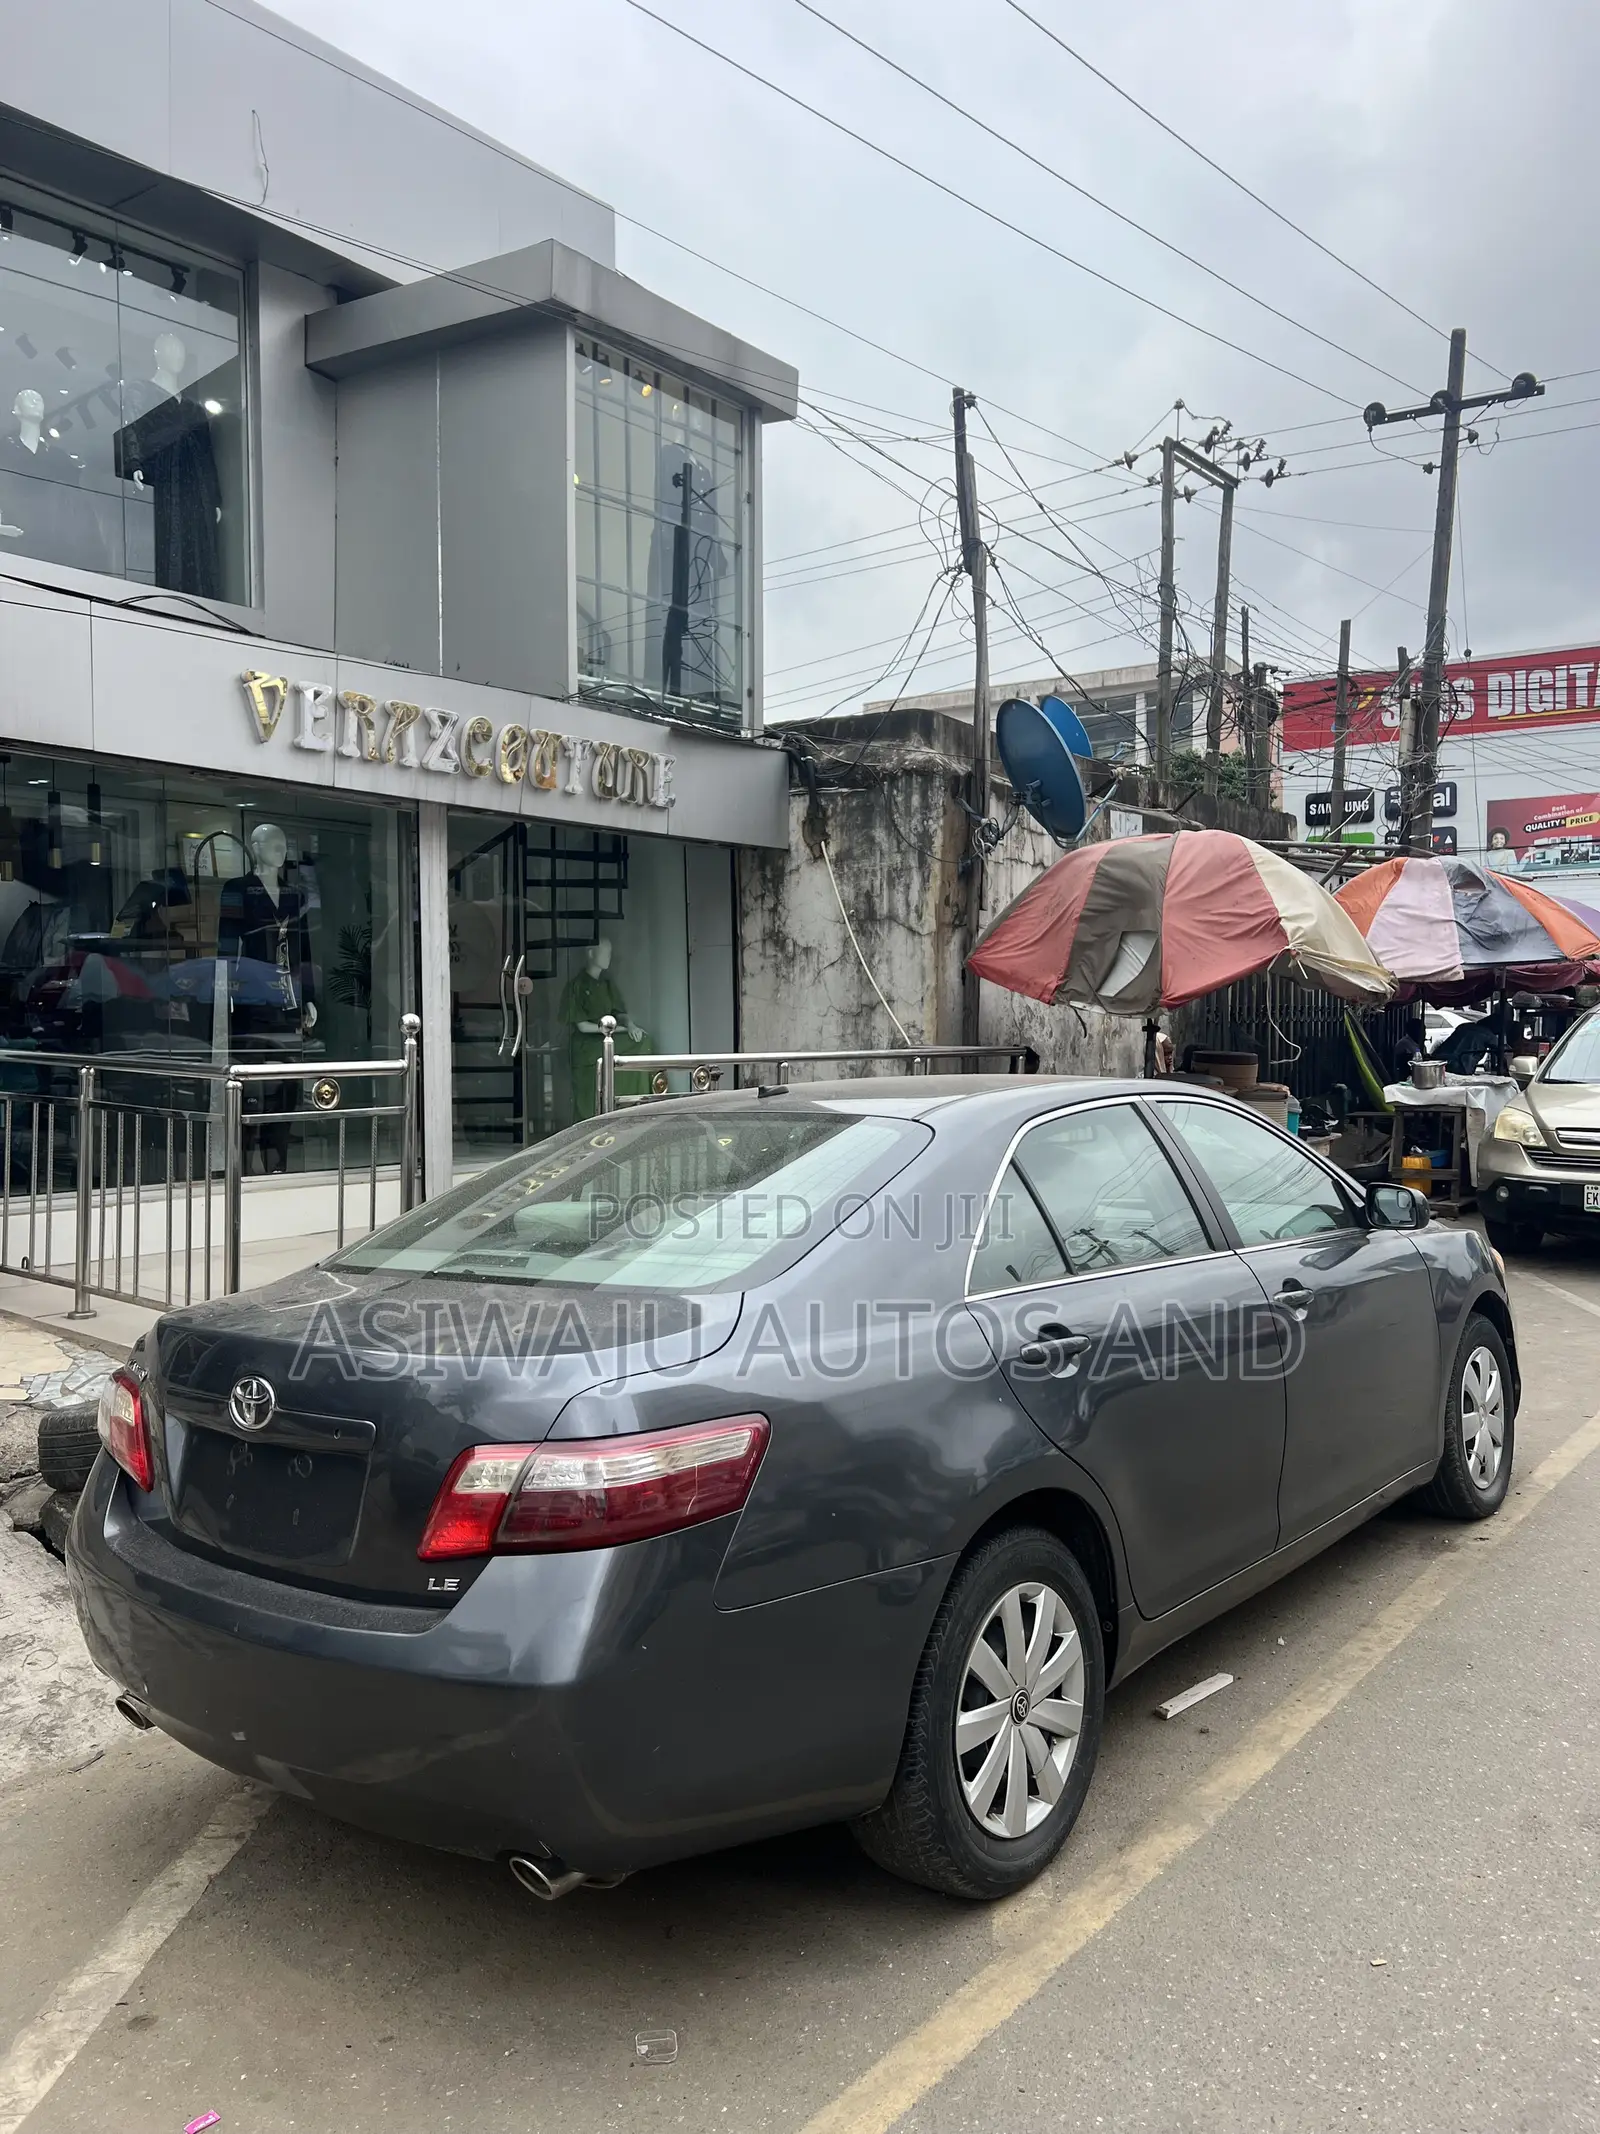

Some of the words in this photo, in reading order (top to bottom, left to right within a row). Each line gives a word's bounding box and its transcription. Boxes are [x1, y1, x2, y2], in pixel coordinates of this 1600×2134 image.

[1381, 677, 1475, 728] SS
[1487, 661, 1600, 718] DIGIT
[1309, 800, 1370, 816] SAMUNG
[1534, 809, 1574, 820] Combination
[1525, 819, 1560, 832] QUALITY
[1570, 816, 1593, 825] PRICE
[427, 1577, 460, 1592] LE
